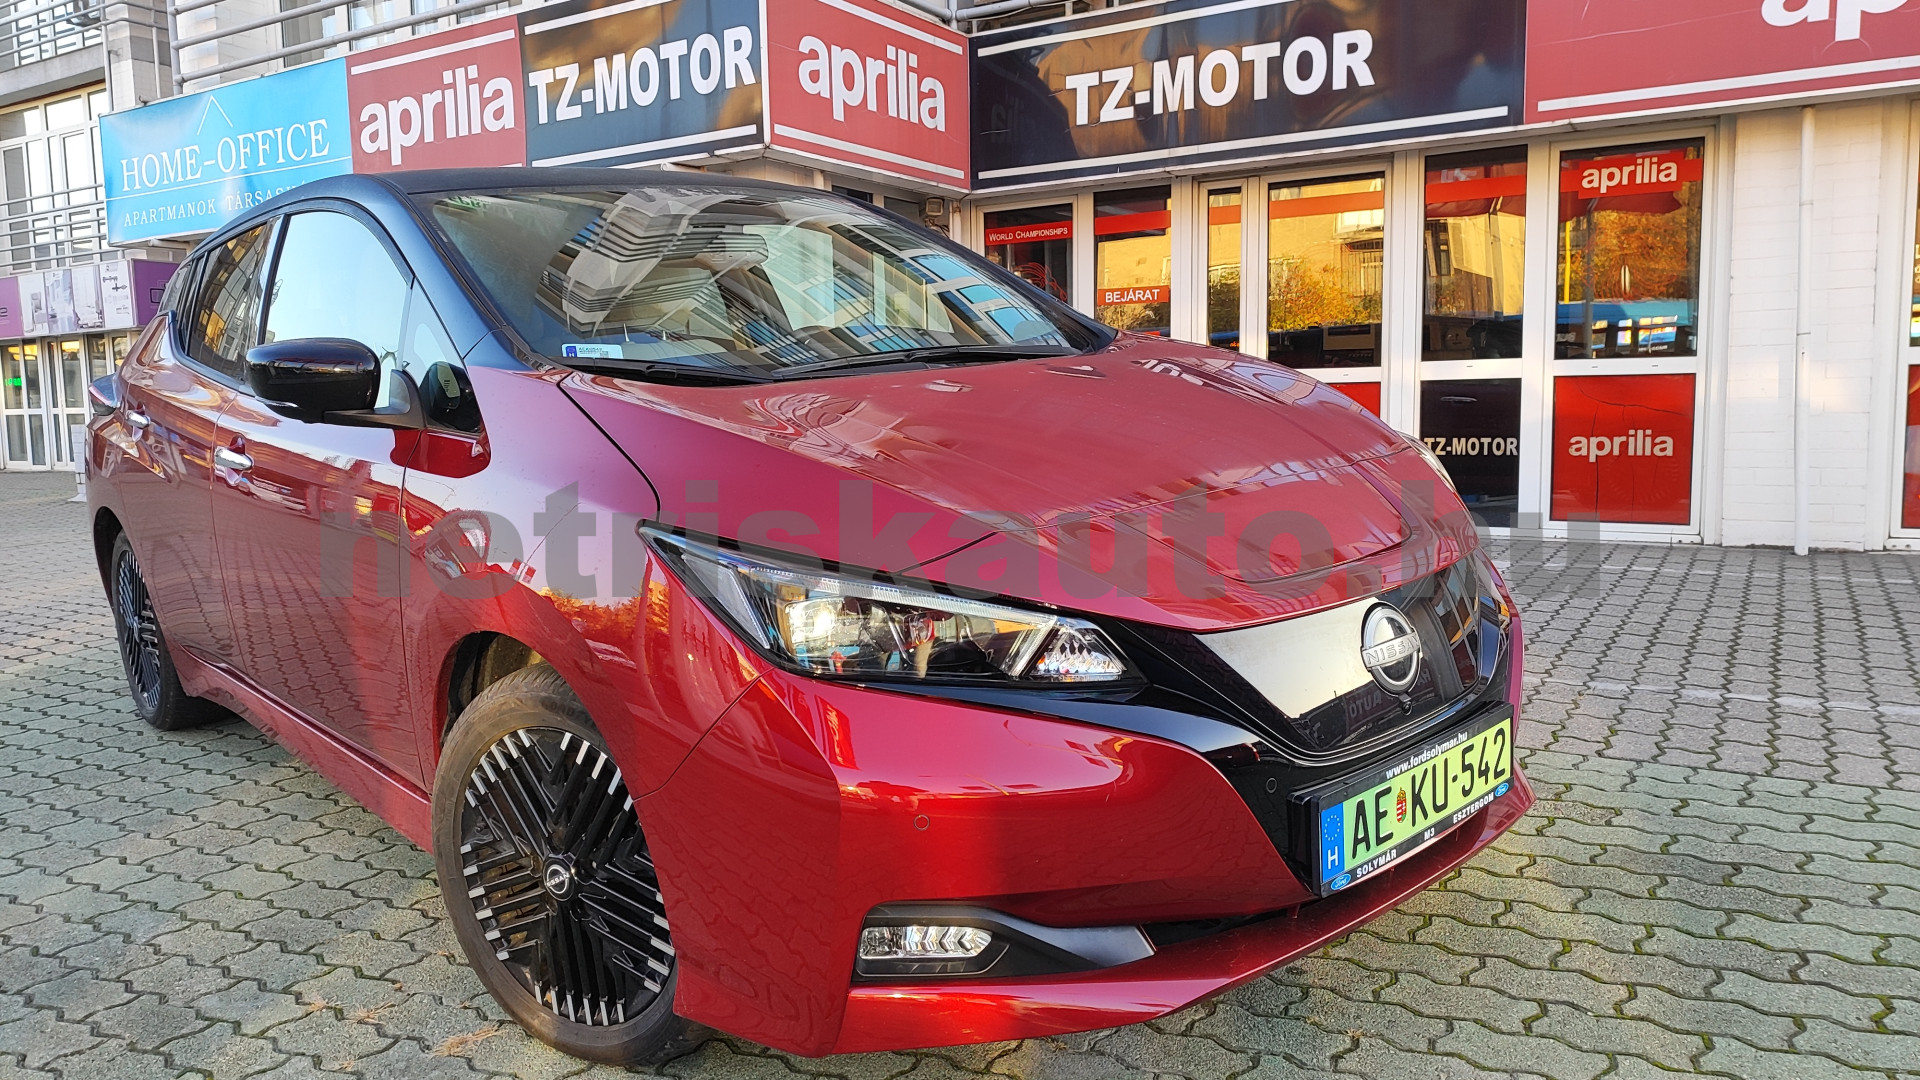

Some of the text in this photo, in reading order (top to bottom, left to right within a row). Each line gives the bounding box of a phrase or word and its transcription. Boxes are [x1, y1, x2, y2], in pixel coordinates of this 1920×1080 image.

[529, 26, 756, 126] TZ-MOTOR
[798, 35, 946, 132] aprilia
[1065, 29, 1375, 127] TZ-MOTOR
[359, 64, 515, 166] aprilia
[120, 119, 330, 192] HOME-OFFICE
[1581, 157, 1678, 194] aprilia
[124, 198, 217, 227] APARTMANOK
[989, 227, 1068, 242] WORLD CHAMPIONSHIPS
[1105, 288, 1160, 303] BEJÁRAT
[1424, 437, 1518, 456] TZ-MOTOR
[1568, 429, 1674, 463] aprilia
[1365, 634, 1421, 665] NISSAN
[1386, 732, 1468, 779] www.fordsolymar.hu
[1352, 786, 1394, 860] AE
[1356, 848, 1397, 878] SOLYMÁR
[1424, 827, 1435, 841] M3
[1453, 791, 1495, 824] ESZTERGOM
[1327, 845, 1339, 870] H
